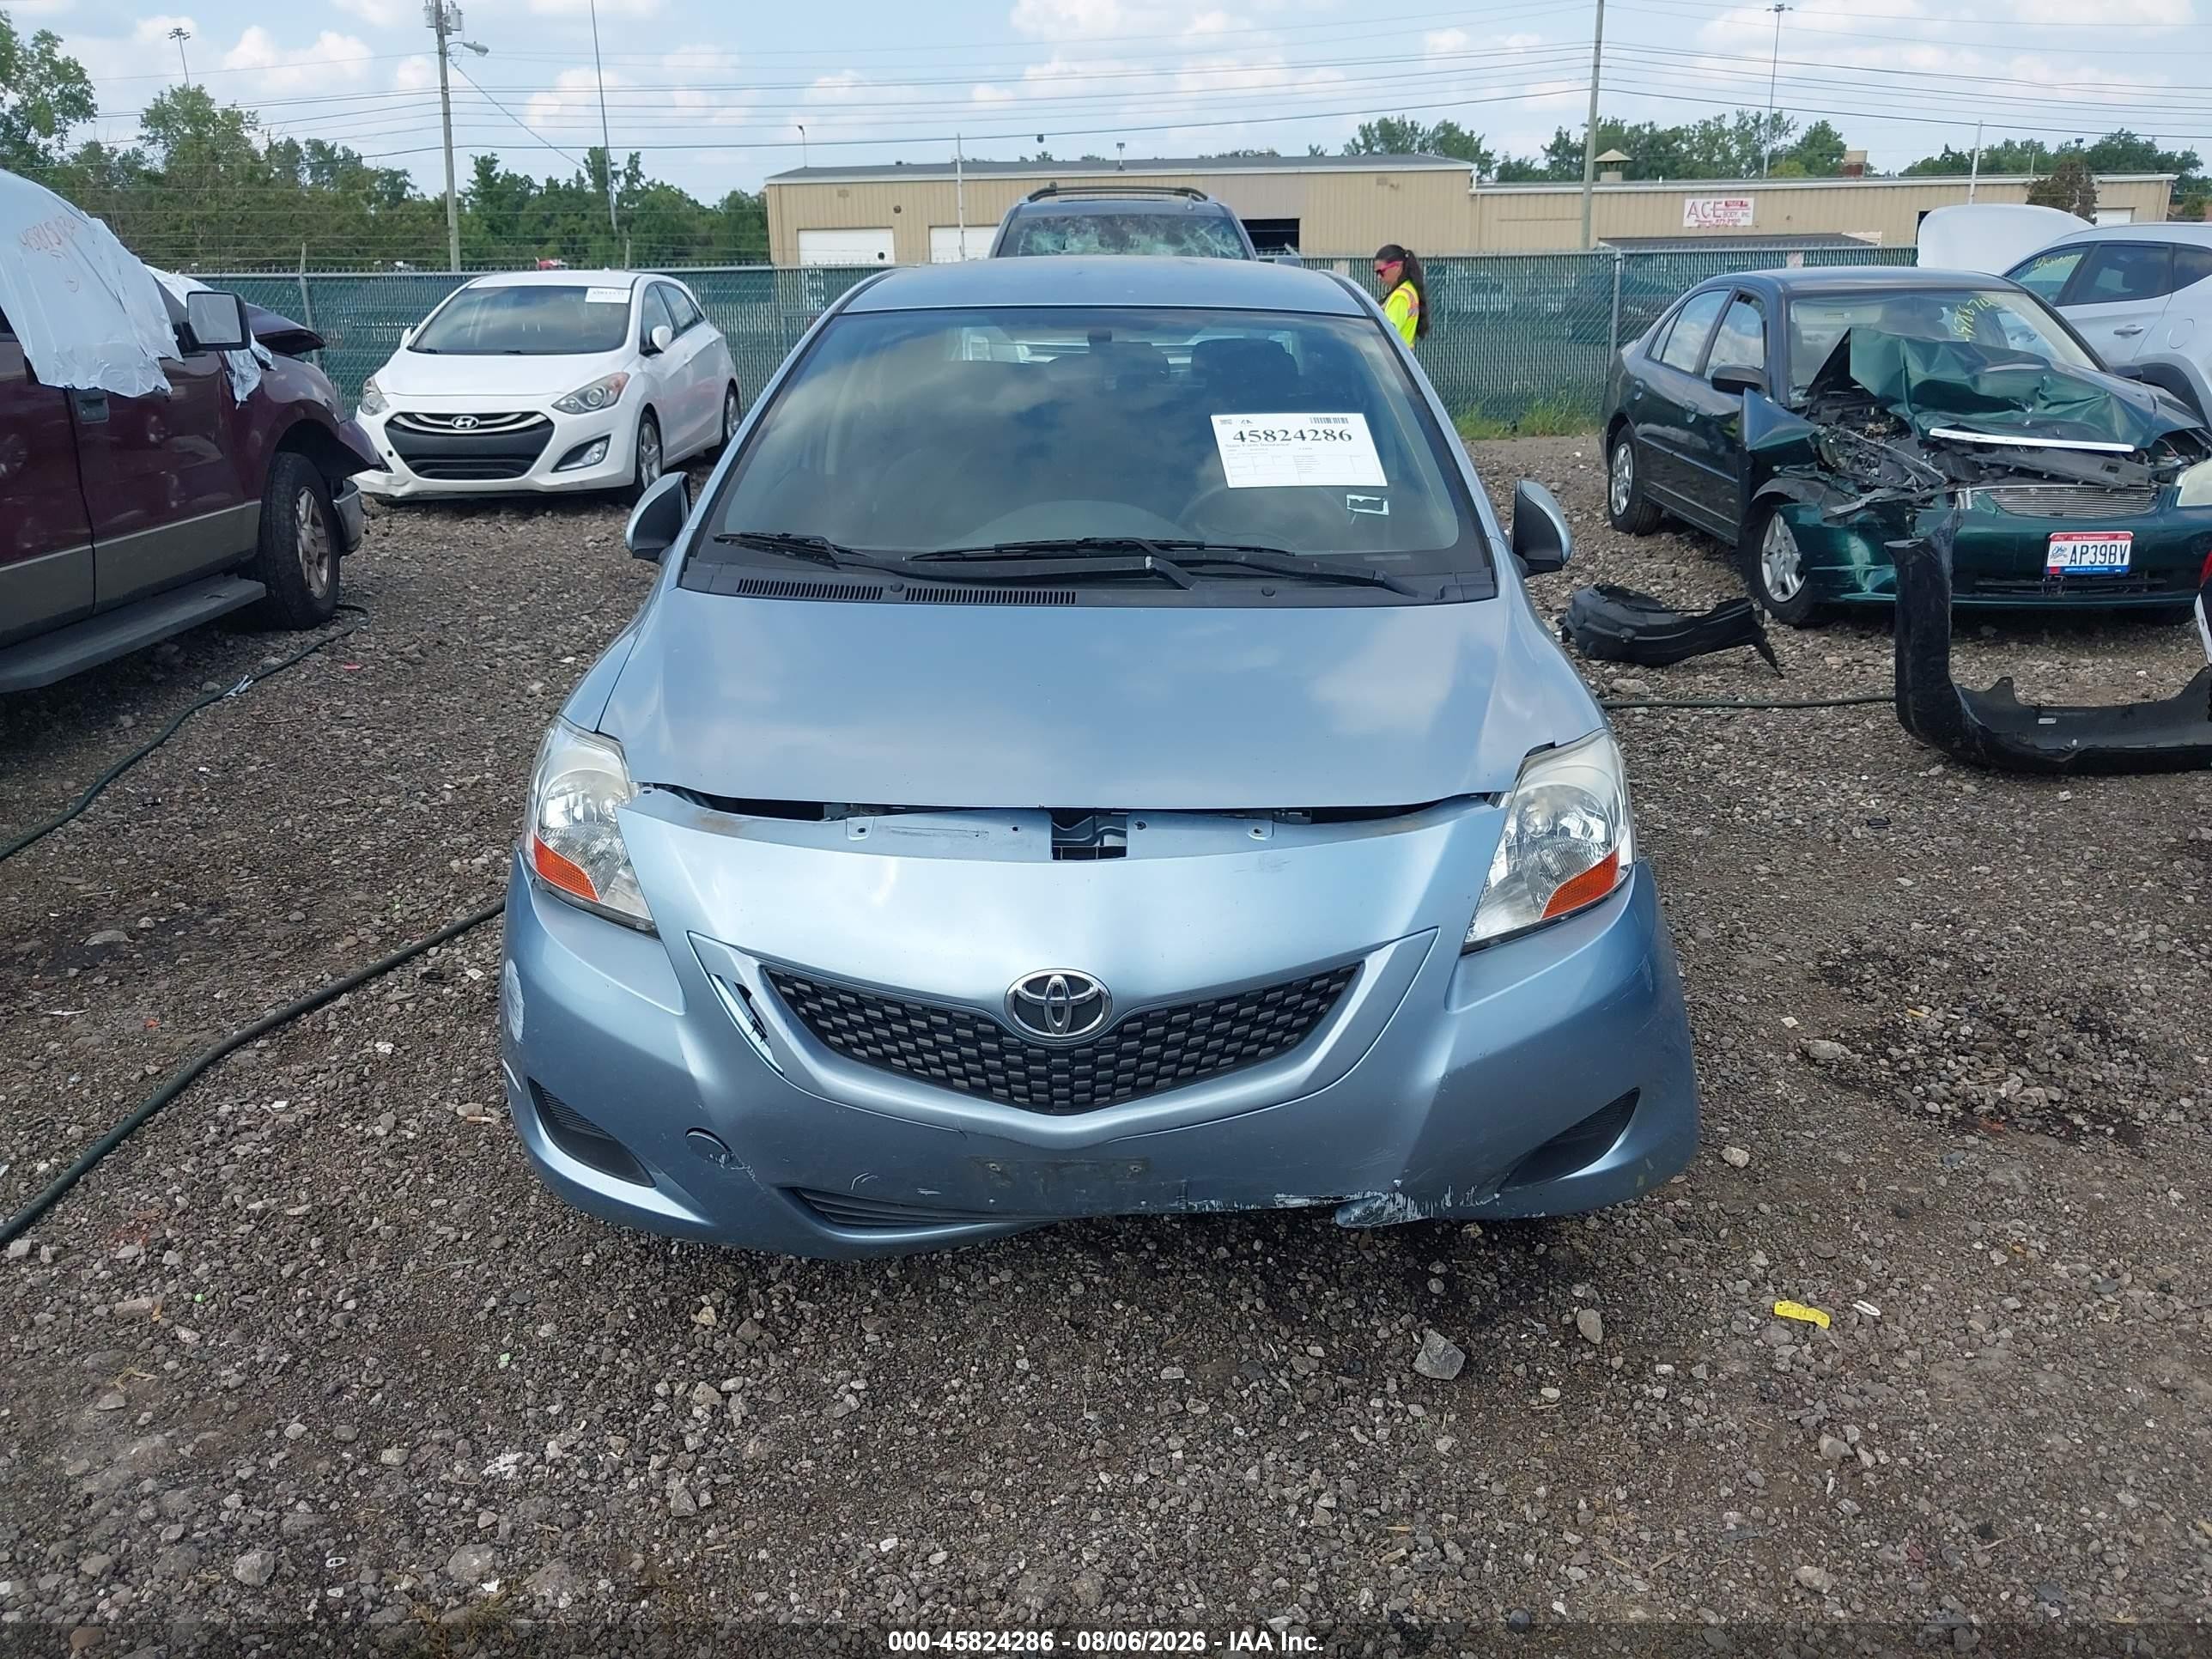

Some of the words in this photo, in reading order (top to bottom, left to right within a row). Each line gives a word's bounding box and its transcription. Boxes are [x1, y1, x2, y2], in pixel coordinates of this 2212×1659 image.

[1686, 200, 1723, 219] ACE
[1233, 428, 1352, 443] 45824286
[2069, 544, 2128, 565] AP39BV
